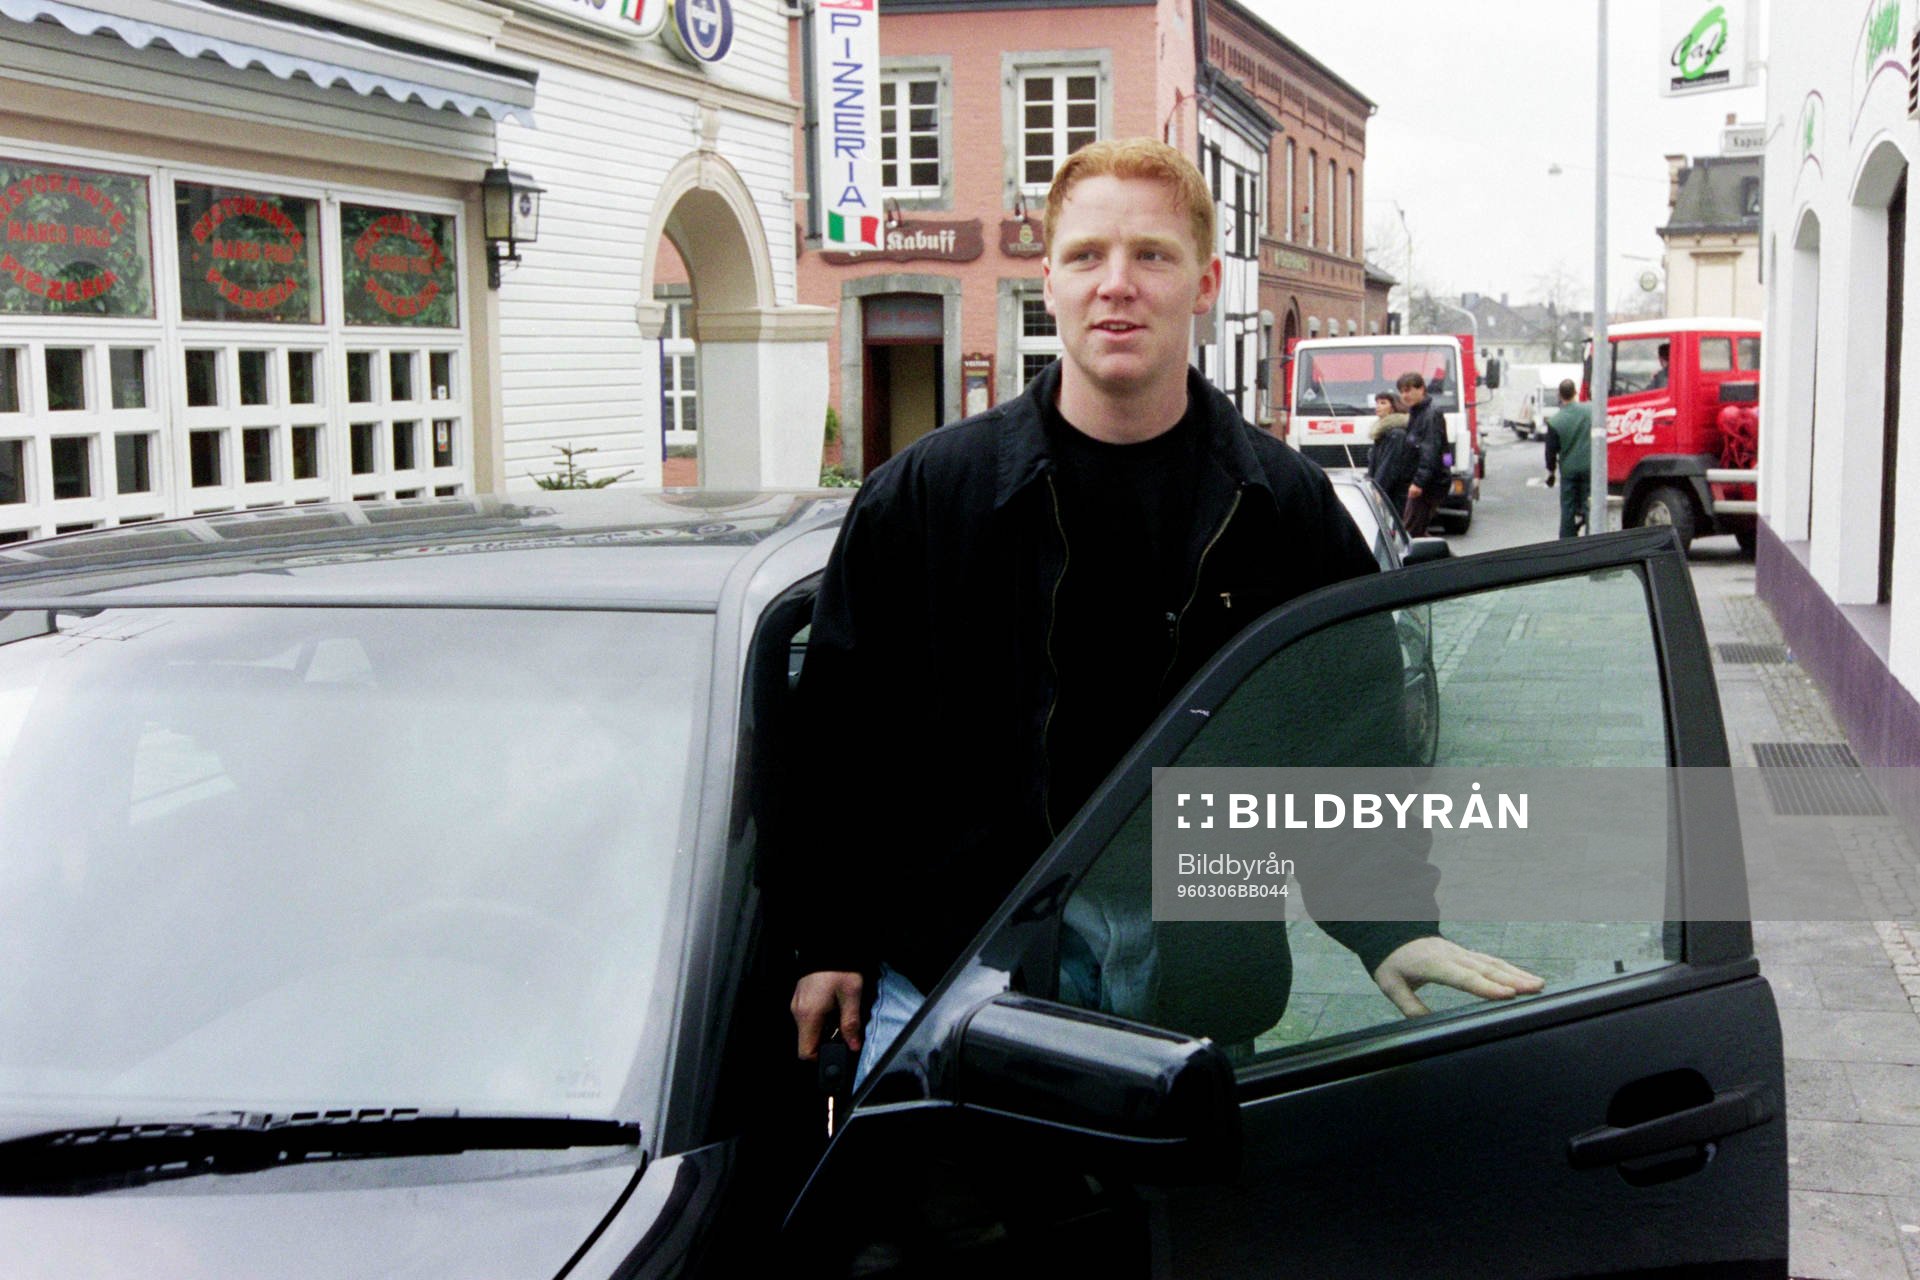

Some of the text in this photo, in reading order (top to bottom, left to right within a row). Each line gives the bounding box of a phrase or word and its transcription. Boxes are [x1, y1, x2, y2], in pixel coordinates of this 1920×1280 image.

[831, 13, 866, 208] PIZZERIA
[0, 172, 127, 234] ISTORANTE
[192, 194, 304, 252] RISTORANTE
[7, 219, 68, 244] MARCO
[212, 239, 260, 261] MARCO
[886, 230, 956, 253] Kabuff
[0, 253, 118, 302] PIZZERIA
[207, 267, 298, 309] PIZZERIA
